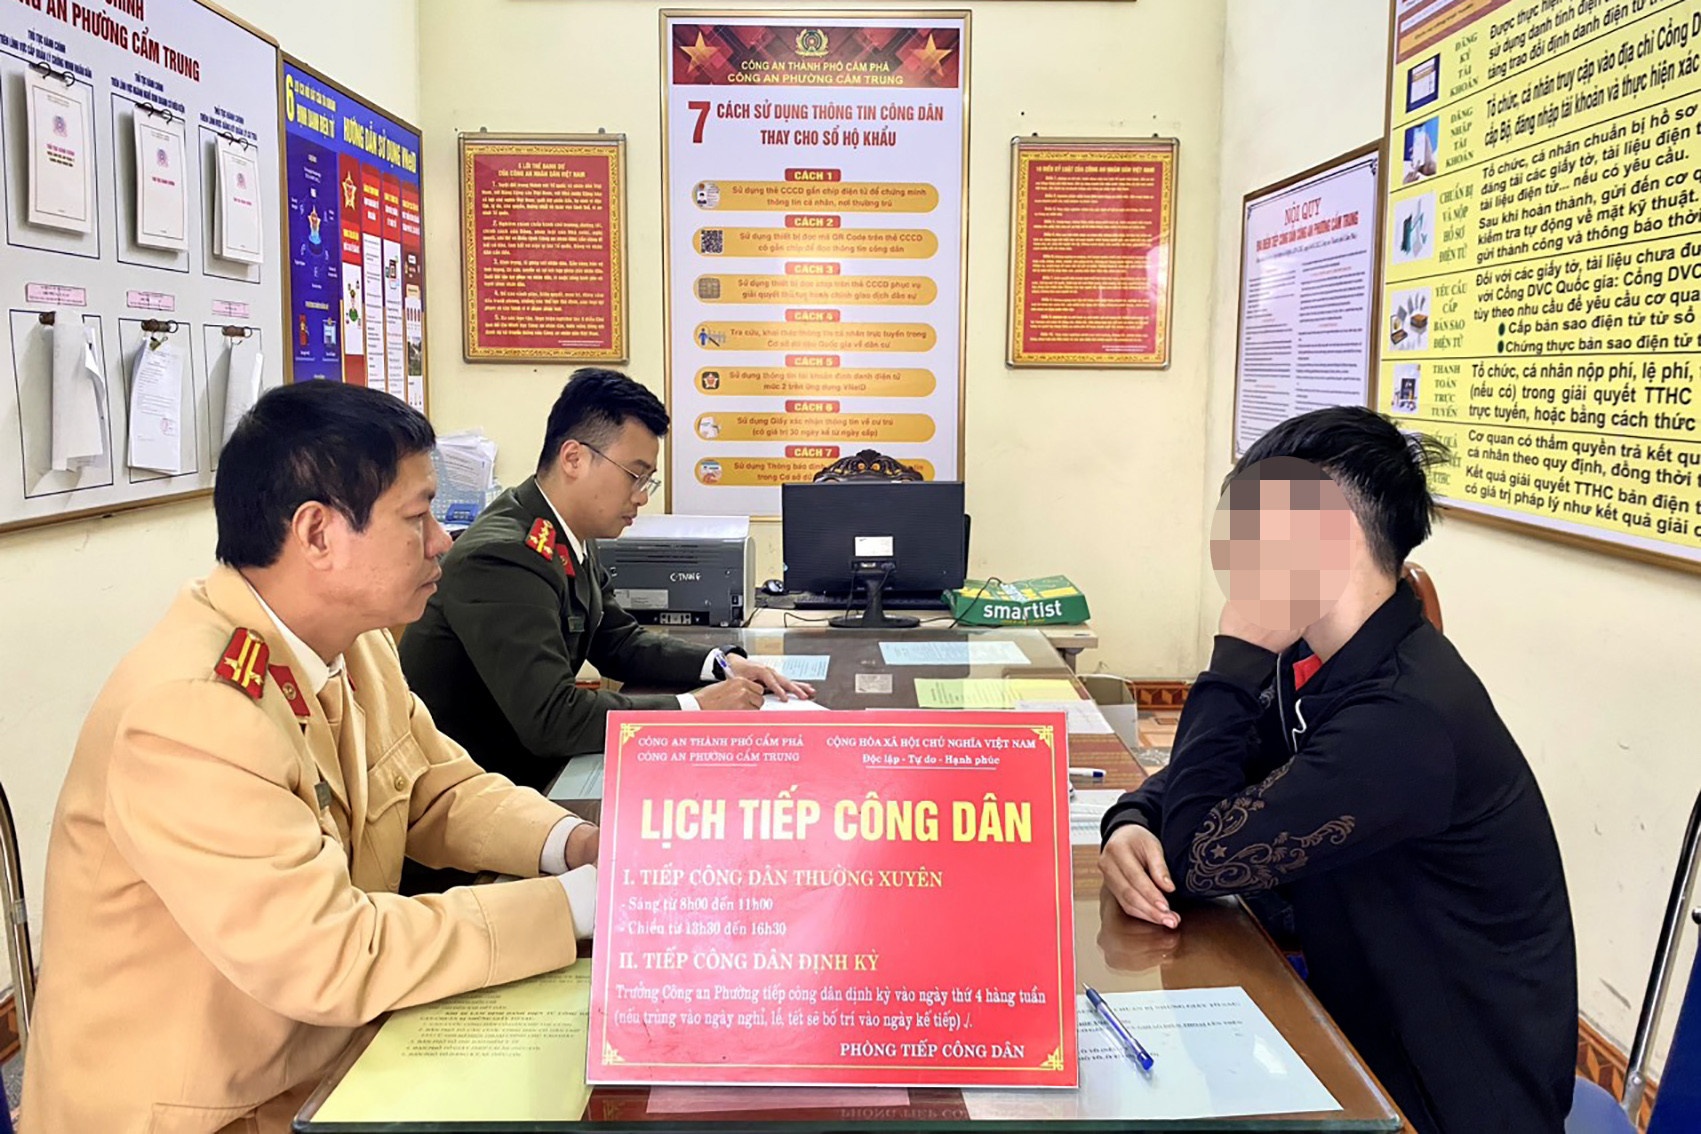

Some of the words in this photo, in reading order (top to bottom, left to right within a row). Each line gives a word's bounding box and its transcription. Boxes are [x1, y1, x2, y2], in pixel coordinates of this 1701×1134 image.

[47, 0, 67, 23] AN
[72, 3, 128, 50] PHƯỜNG
[132, 26, 159, 64] CẨM
[163, 46, 200, 82] TRUNG
[741, 60, 769, 71] CÔNG
[772, 61, 785, 71] AN
[788, 60, 821, 72] THÀNH
[728, 73, 760, 83] CÔNG
[764, 74, 779, 83] AN
[782, 72, 833, 84] PHƯỜNG
[865, 75, 903, 85] TRUNG
[286, 74, 295, 122] 6
[717, 100, 750, 119] CÁCH
[754, 99, 771, 119] SỬ
[775, 105, 808, 122] DỤNG
[813, 102, 852, 121] THÔNG
[857, 105, 876, 120] TIN
[880, 102, 914, 121] CÔNG
[918, 102, 943, 121] DÂN
[688, 101, 711, 143] 7
[761, 130, 789, 145] THAY
[794, 130, 819, 145] CHO
[823, 125, 839, 146] SỔ
[843, 130, 859, 149] HỘ
[863, 125, 896, 147] KHẨU
[794, 171, 823, 180] CÁCH
[827, 172, 833, 180] 1
[1302, 197, 1321, 219] QUY
[794, 217, 823, 226] CÁCH
[1508, 321, 1532, 335] Cấp
[1535, 318, 1558, 332] bản
[1562, 319, 1587, 330] sao
[1592, 315, 1623, 330] điện
[1472, 361, 1485, 378] Tổ
[1488, 364, 1519, 380] chức,
[1522, 364, 1537, 377] cá
[1541, 363, 1573, 378] nhân
[1577, 362, 1604, 382] nộp
[1609, 363, 1637, 382] phí,
[1642, 362, 1656, 383] lệ
[1661, 362, 1694, 383] phí,
[1470, 381, 1493, 400] (nếu
[1499, 384, 1516, 401] có)
[1522, 385, 1555, 403] trong
[1562, 384, 1586, 403] giải
[1593, 383, 1636, 405] quyết
[1645, 387, 1692, 405] TTHC
[794, 402, 823, 411] CÁCH
[1469, 404, 1491, 420] trực
[1494, 401, 1530, 422] tuyến,
[1534, 406, 1565, 425] hoặc
[1570, 404, 1605, 428] bằng
[1611, 407, 1648, 428] cách
[1655, 410, 1696, 431] thức
[794, 447, 823, 457] CÁCH
[826, 449, 832, 457] 7
[983, 600, 1062, 620] smartist
[638, 735, 668, 746] CÔNG
[672, 738, 687, 746] AN
[690, 735, 728, 746] THÀNH
[731, 734, 754, 746] PHỐ
[782, 734, 804, 746] PHẢ
[826, 736, 856, 747] CỘNG
[859, 735, 882, 747] HÒA
[884, 736, 898, 747] XÃ
[900, 737, 920, 748] HỘI
[923, 736, 944, 747] CHỦ
[948, 737, 982, 748] NGHĨA
[985, 737, 1009, 750] VIỆT
[1013, 740, 1036, 749] NAM
[638, 751, 667, 761] CÔNG
[671, 753, 686, 761] AN
[690, 751, 733, 761] PHƯỜNG
[764, 752, 799, 761] TRUNG
[863, 754, 881, 764] Độc
[884, 754, 900, 765] lập
[908, 755, 921, 765] Tự
[924, 755, 937, 764] do
[945, 755, 972, 766] Hạnh
[975, 754, 1000, 766] phúc
[641, 799, 726, 849] LỊCH
[739, 784, 821, 840] TIẾP
[834, 791, 939, 841] CÔNG
[952, 793, 1032, 842] DÂN
[623, 870, 635, 886] I.
[640, 862, 684, 886] TIẾP
[689, 865, 742, 886] CÔNG
[749, 865, 788, 886] DÂN
[793, 864, 874, 887] THƯỜNG
[878, 866, 943, 887] XUYÊN
[628, 897, 659, 913] Sáng
[663, 897, 678, 911] từ
[680, 897, 708, 911] 8h00
[712, 897, 734, 911] đến
[738, 898, 773, 911] 11h00
[669, 921, 682, 935] từ
[686, 922, 720, 935] 13h30
[724, 921, 746, 935] đến
[752, 922, 787, 935] 16h30
[619, 953, 638, 969] II.
[643, 946, 688, 969] TIẾP
[693, 948, 747, 970] CÔNG
[754, 949, 793, 970] DÂN
[798, 952, 848, 975] ĐỊNH
[854, 949, 879, 971] KỲ
[617, 982, 659, 1004] Trưởng
[662, 984, 692, 1004] Công
[696, 989, 710, 999] an
[714, 984, 759, 1004] Phường
[763, 983, 786, 1003] tiếp
[789, 986, 816, 1004] công
[821, 986, 842, 1000] dân
[877, 987, 891, 1005] kỳ
[895, 988, 914, 1001] vào
[919, 987, 948, 1005] ngày
[951, 987, 972, 1002] thứ
[975, 990, 982, 1002] 4
[986, 987, 1016, 1006] hàng
[1020, 986, 1045, 1003] tuần
[840, 1040, 896, 1057] PHÒNG
[900, 1038, 938, 1058] TIẾP
[942, 1041, 987, 1058] CÔNG
[991, 1041, 1024, 1058] DÂN
